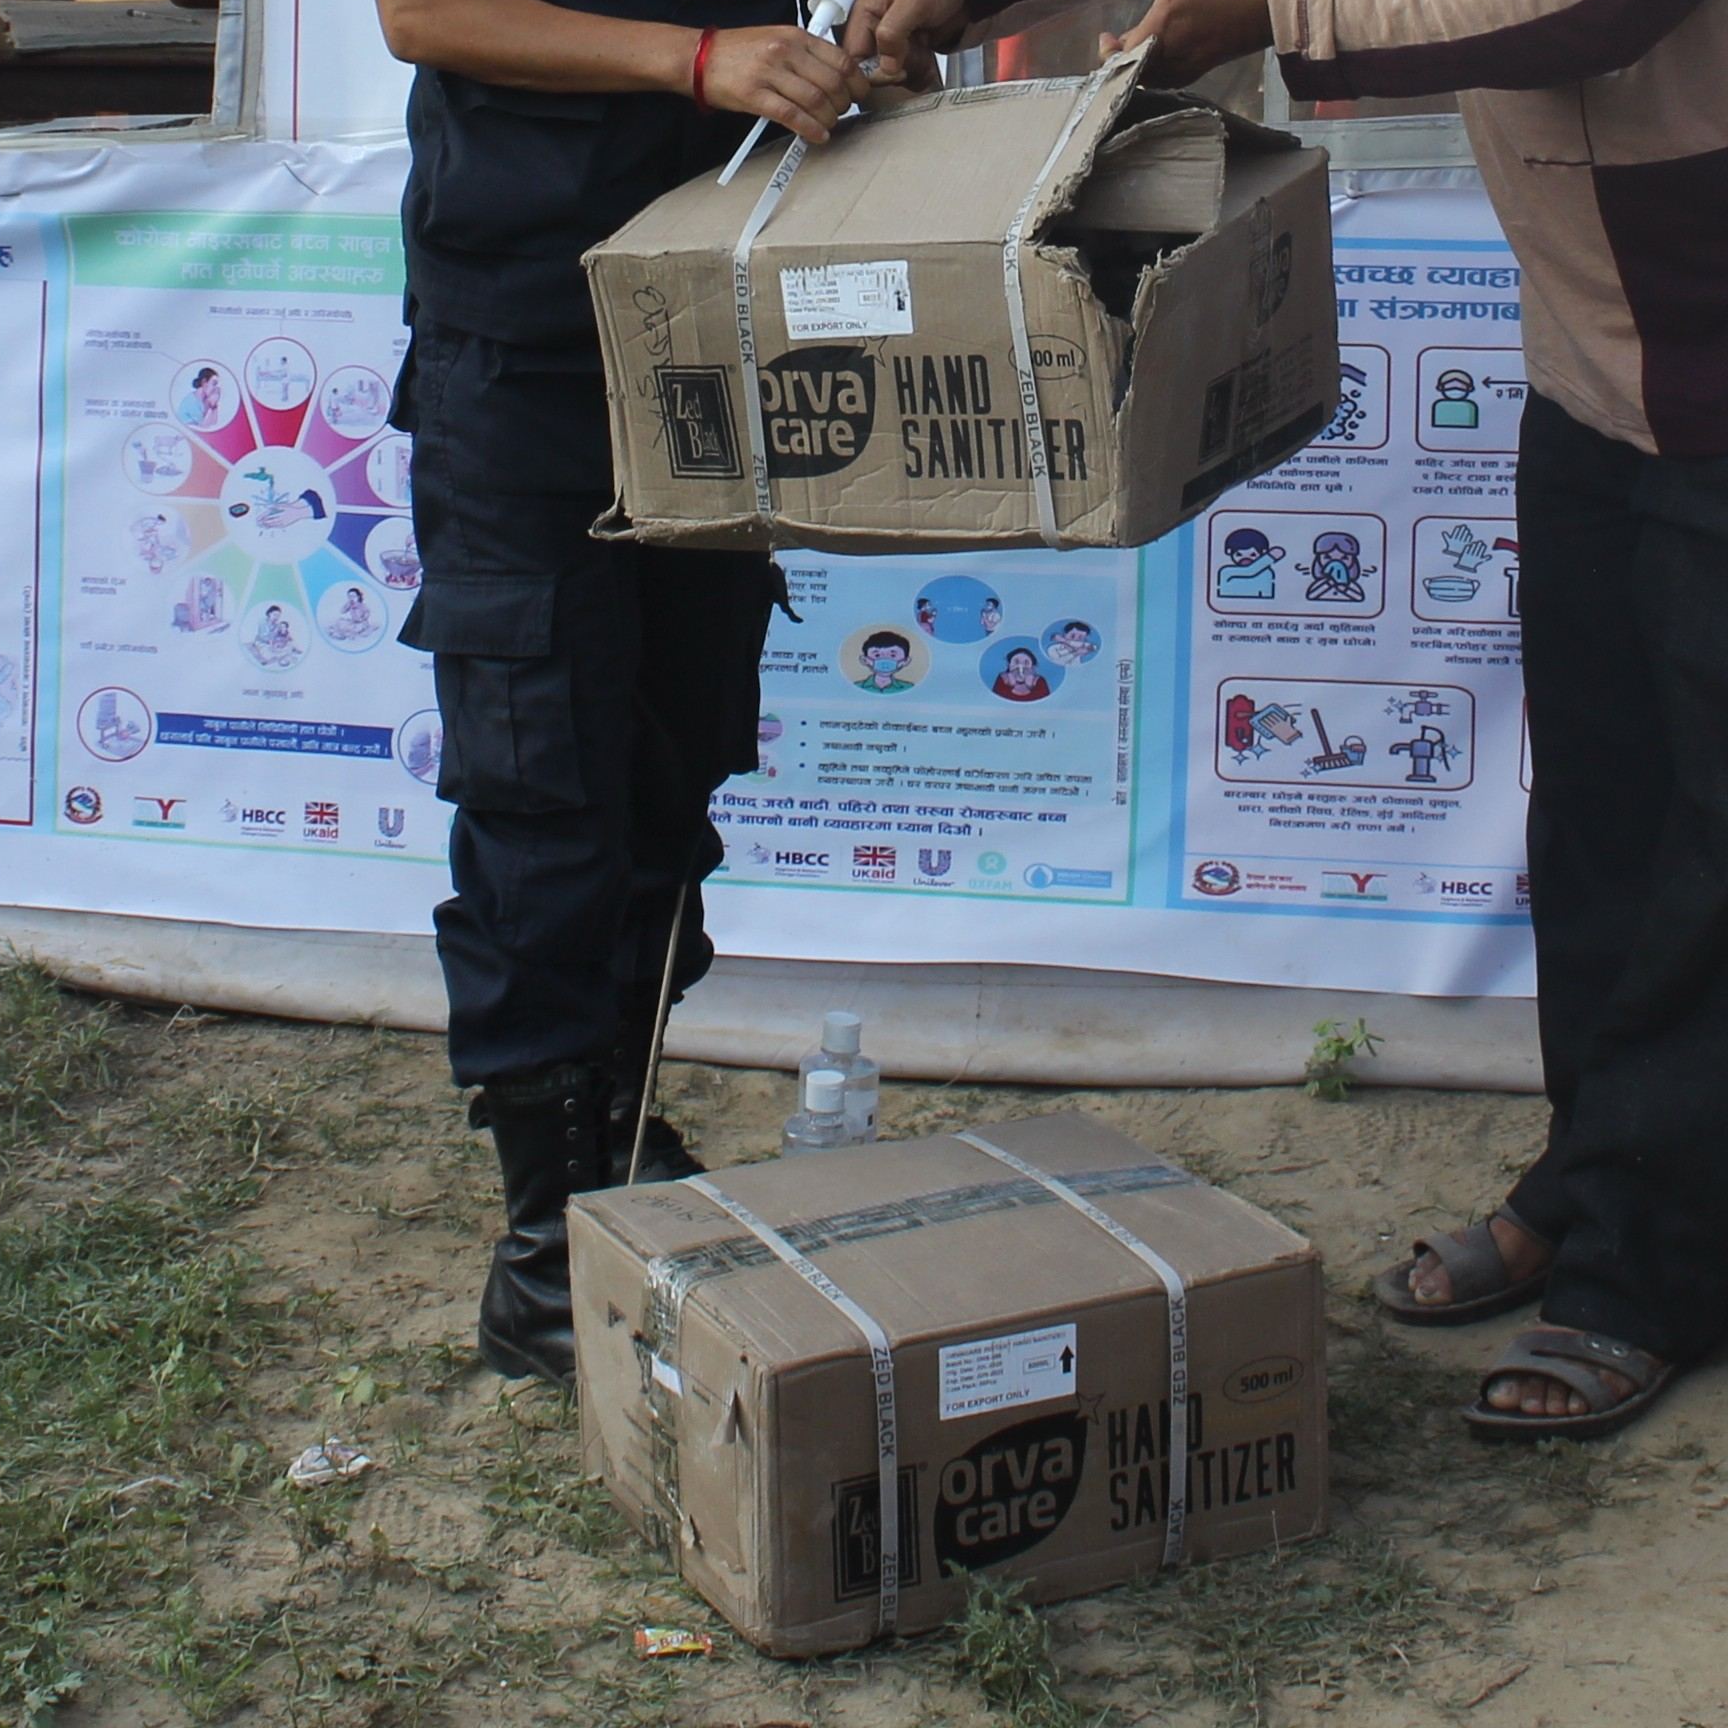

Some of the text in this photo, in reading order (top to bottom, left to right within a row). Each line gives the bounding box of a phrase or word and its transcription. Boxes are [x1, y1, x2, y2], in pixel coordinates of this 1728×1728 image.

[770, 145, 805, 193] BLACK
[337, 234, 391, 259] साबुन
[1427, 266, 1521, 289] व्यवहा
[735, 262, 756, 365] ZED BLACK
[1369, 296, 1522, 321] संक्रमणब
[811, 322, 844, 332] EXPORT
[845, 321, 870, 330] ONLY
[760, 367, 868, 416] orva
[893, 354, 992, 415] HAND
[771, 416, 856, 457] care
[1018, 369, 1047, 478] ZED BLACK
[902, 418, 1089, 483] SANITIER
[242, 807, 286, 826] HBCC
[722, 793, 758, 809] विपद
[882, 804, 910, 816] तथा
[1037, 812, 1068, 824] बच्न
[787, 815, 819, 829] बानी
[775, 850, 830, 868] HBCC
[1440, 880, 1494, 897] HBCC
[1239, 1365, 1294, 1395] 500 ml
[873, 1346, 895, 1458] ZED BLACK
[967, 1392, 1005, 1408] EXPORT
[1006, 1388, 1030, 1401] ONLY
[941, 1435, 1074, 1502] orva
[955, 1491, 1057, 1548] care
